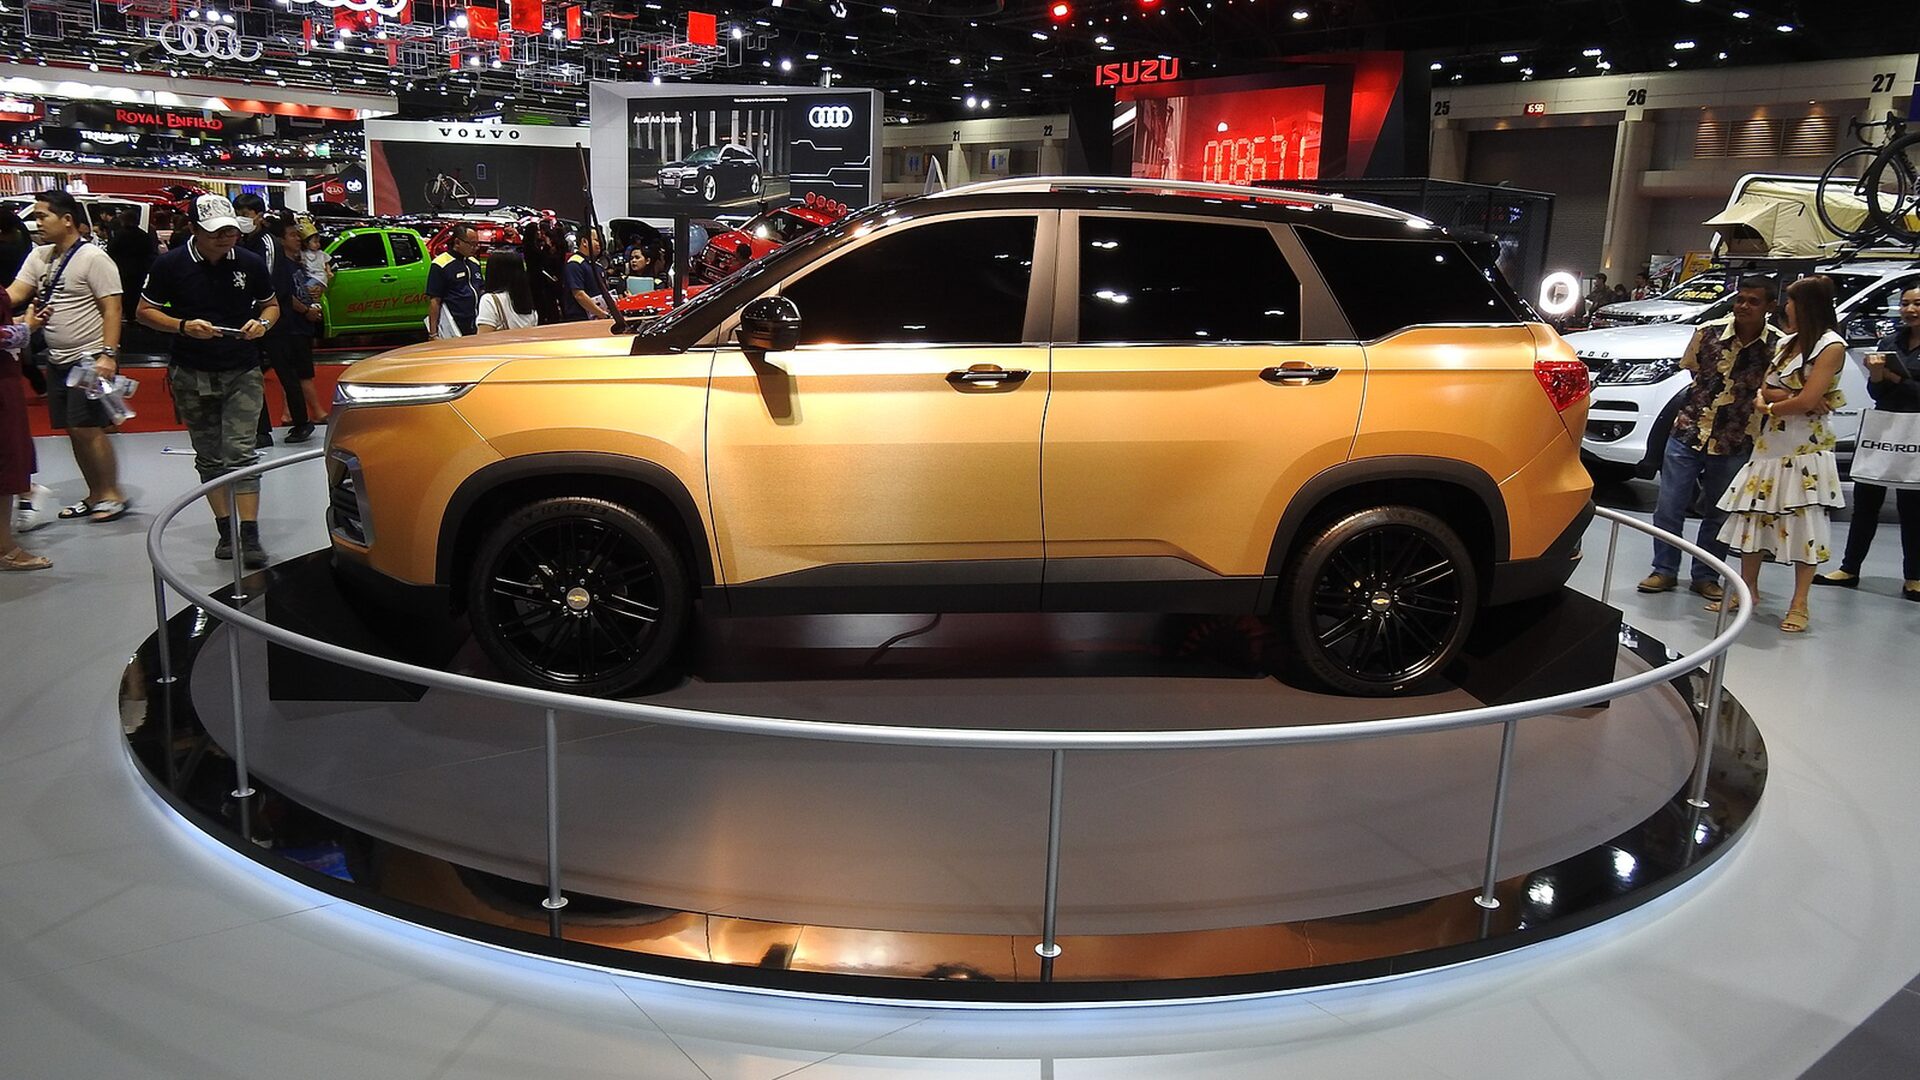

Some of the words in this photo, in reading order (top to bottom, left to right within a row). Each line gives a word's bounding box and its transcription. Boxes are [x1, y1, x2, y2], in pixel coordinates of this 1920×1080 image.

[1095, 57, 1180, 86] ISUZU
[1871, 73, 1896, 93] 27
[1627, 89, 1647, 106] 26
[1434, 101, 1450, 116] 25
[116, 109, 162, 125] ROYAL
[167, 114, 223, 130] ENFIELD
[80, 130, 129, 144] TRIUMPH
[438, 127, 521, 140] VOLVO
[952, 131, 960, 141] 21
[1044, 125, 1053, 136] 22
[346, 296, 400, 313] SAFETY
